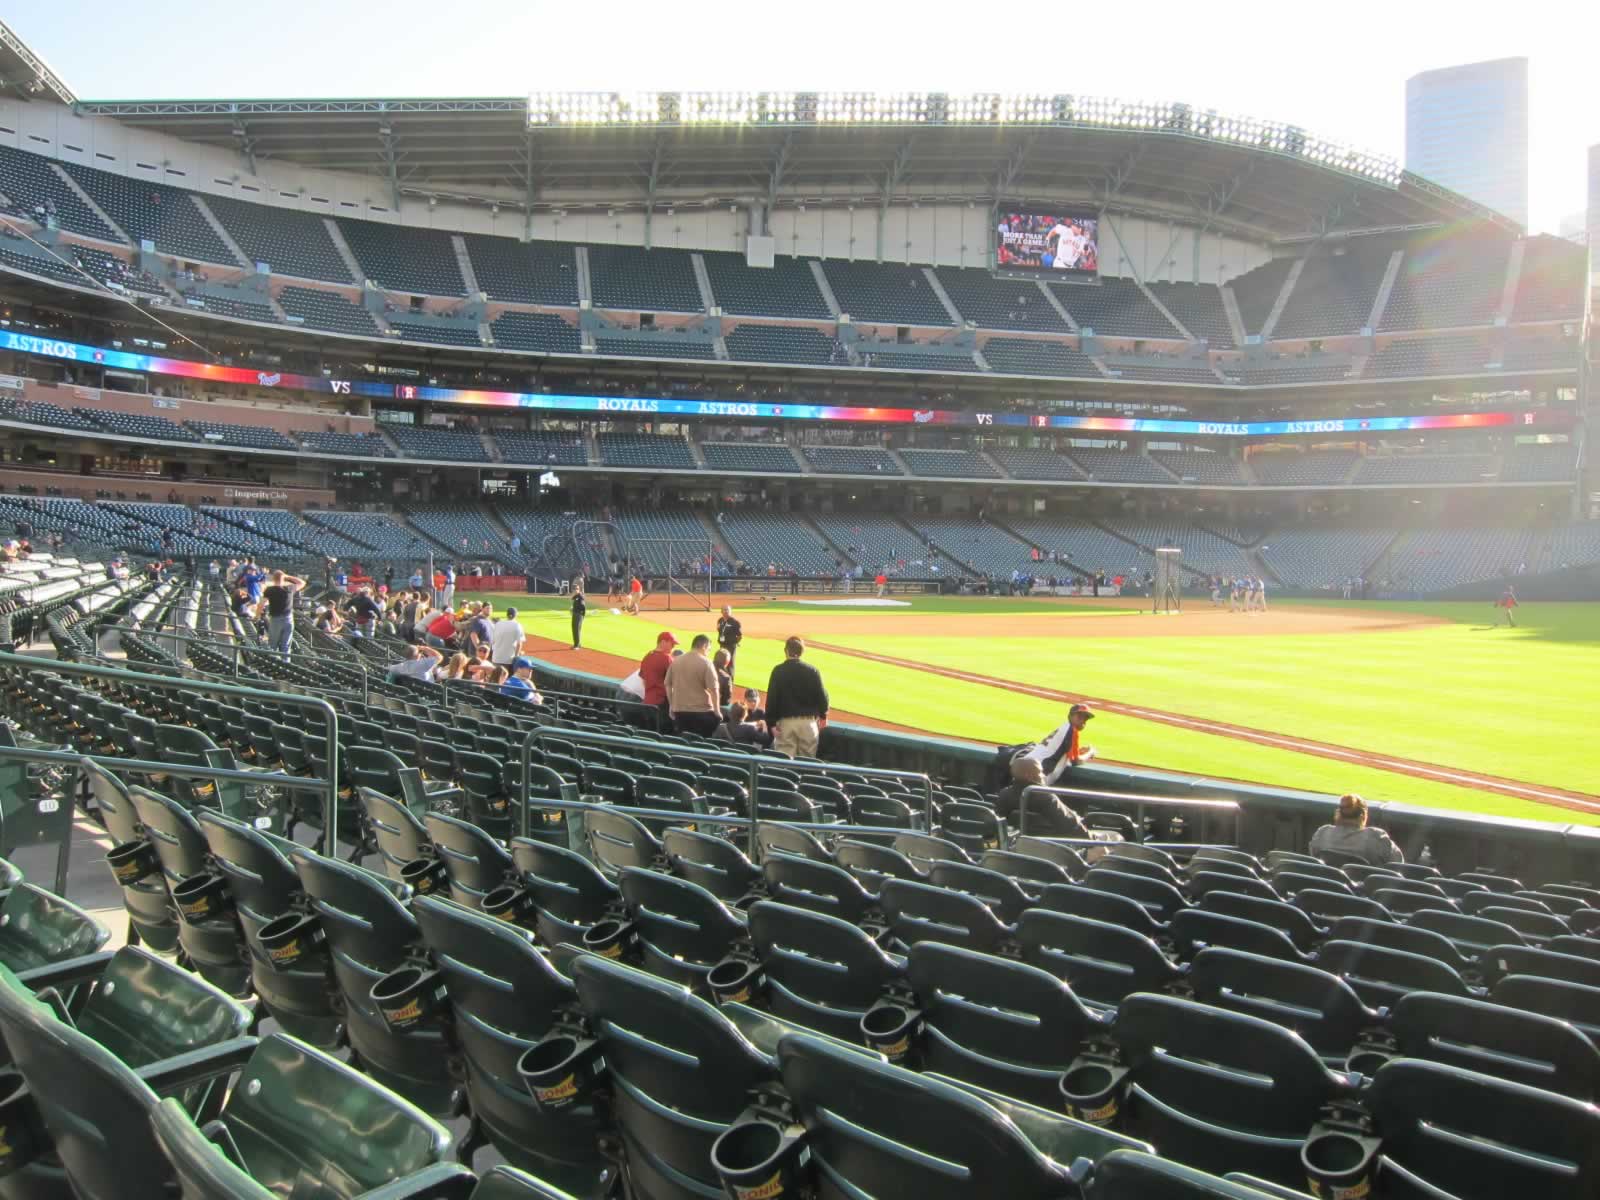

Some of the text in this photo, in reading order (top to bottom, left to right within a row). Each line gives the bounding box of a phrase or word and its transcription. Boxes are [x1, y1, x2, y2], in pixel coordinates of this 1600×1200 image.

[7, 333, 77, 359] ASTROS
[330, 380, 351, 394] VS
[598, 399, 659, 412] ROYALS
[698, 402, 758, 416] ASTROS
[976, 413, 992, 425] VS
[1287, 419, 1344, 433] ASTROS
[1199, 423, 1249, 435] ROYALS
[536, 1082, 574, 1101] SONIC
[737, 1181, 780, 1200] SONIC
